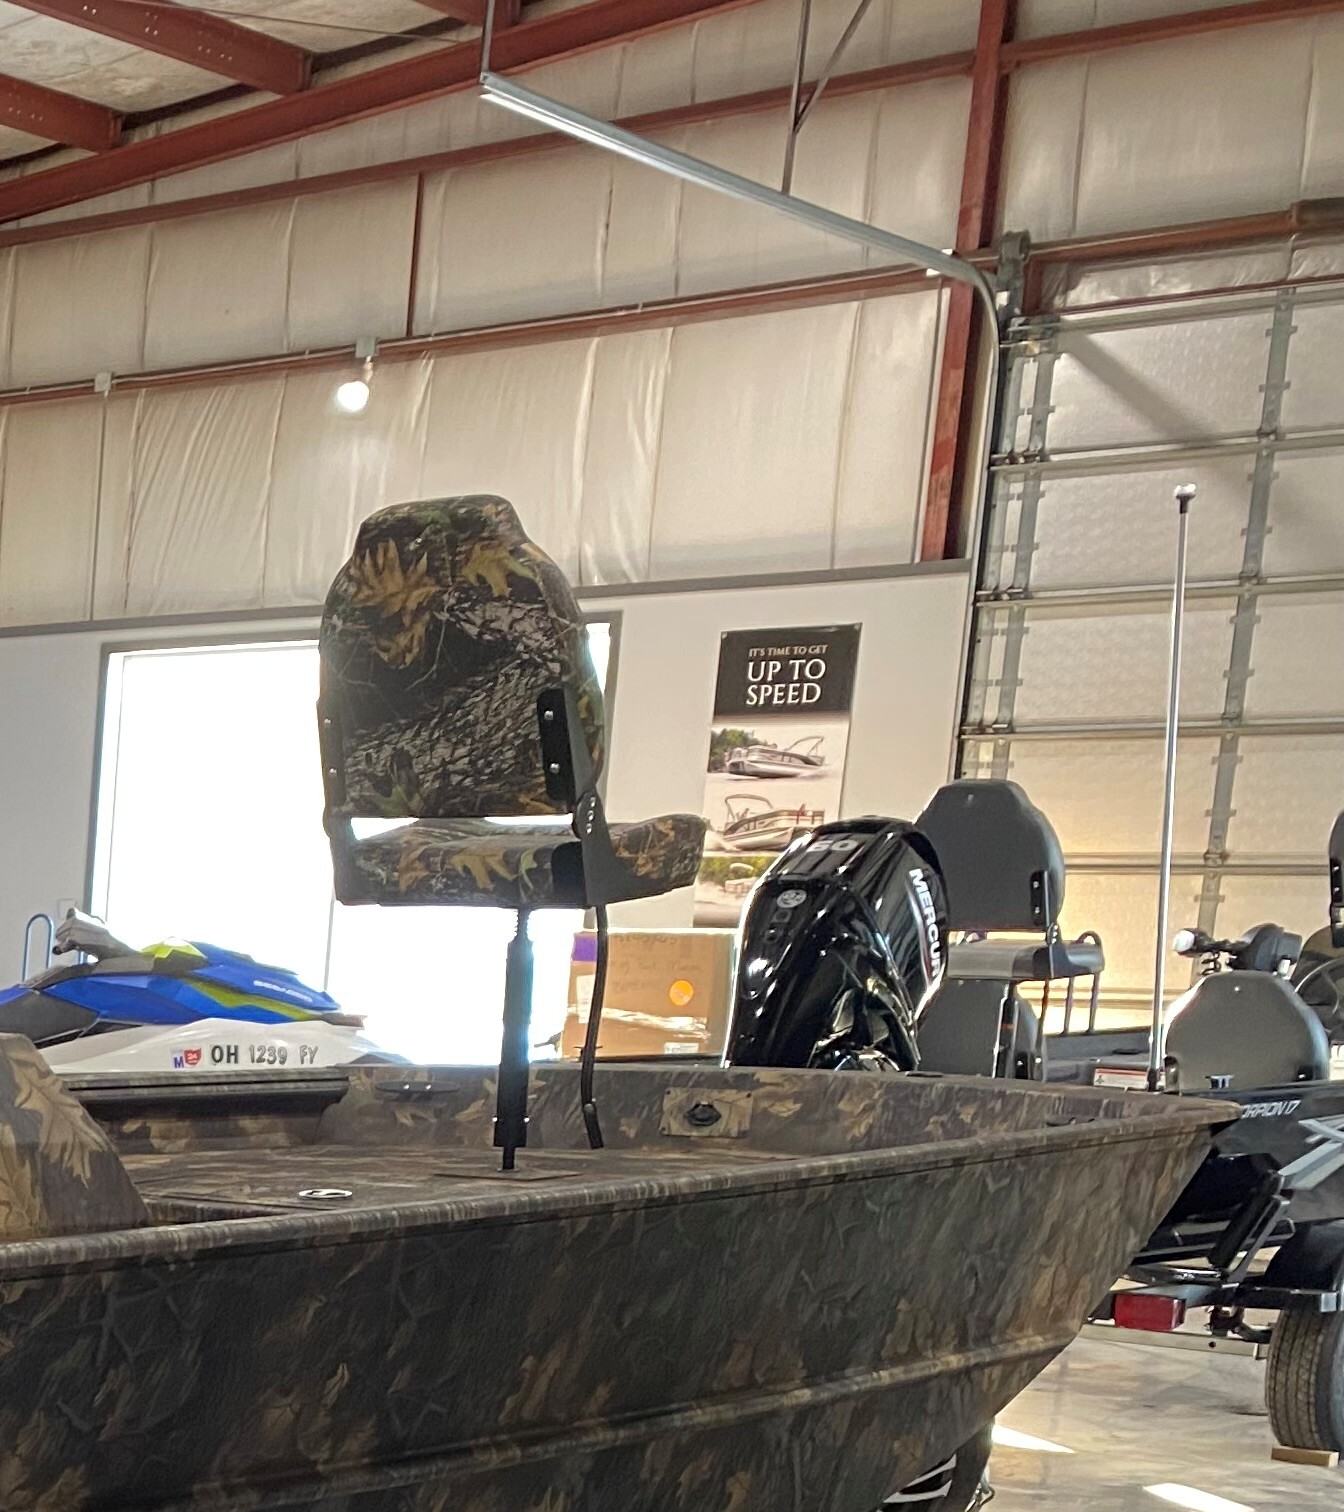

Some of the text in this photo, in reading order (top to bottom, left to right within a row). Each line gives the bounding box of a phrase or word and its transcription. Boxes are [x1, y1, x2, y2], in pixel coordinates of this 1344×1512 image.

[748, 644, 829, 657] IT'S TIME TO GET
[746, 658, 826, 682] UP TO
[745, 682, 822, 706] SPEED
[909, 868, 942, 978] MERCUR
[211, 1044, 319, 1066] OH 1239 FY
[1241, 1101, 1287, 1119] ORPION
